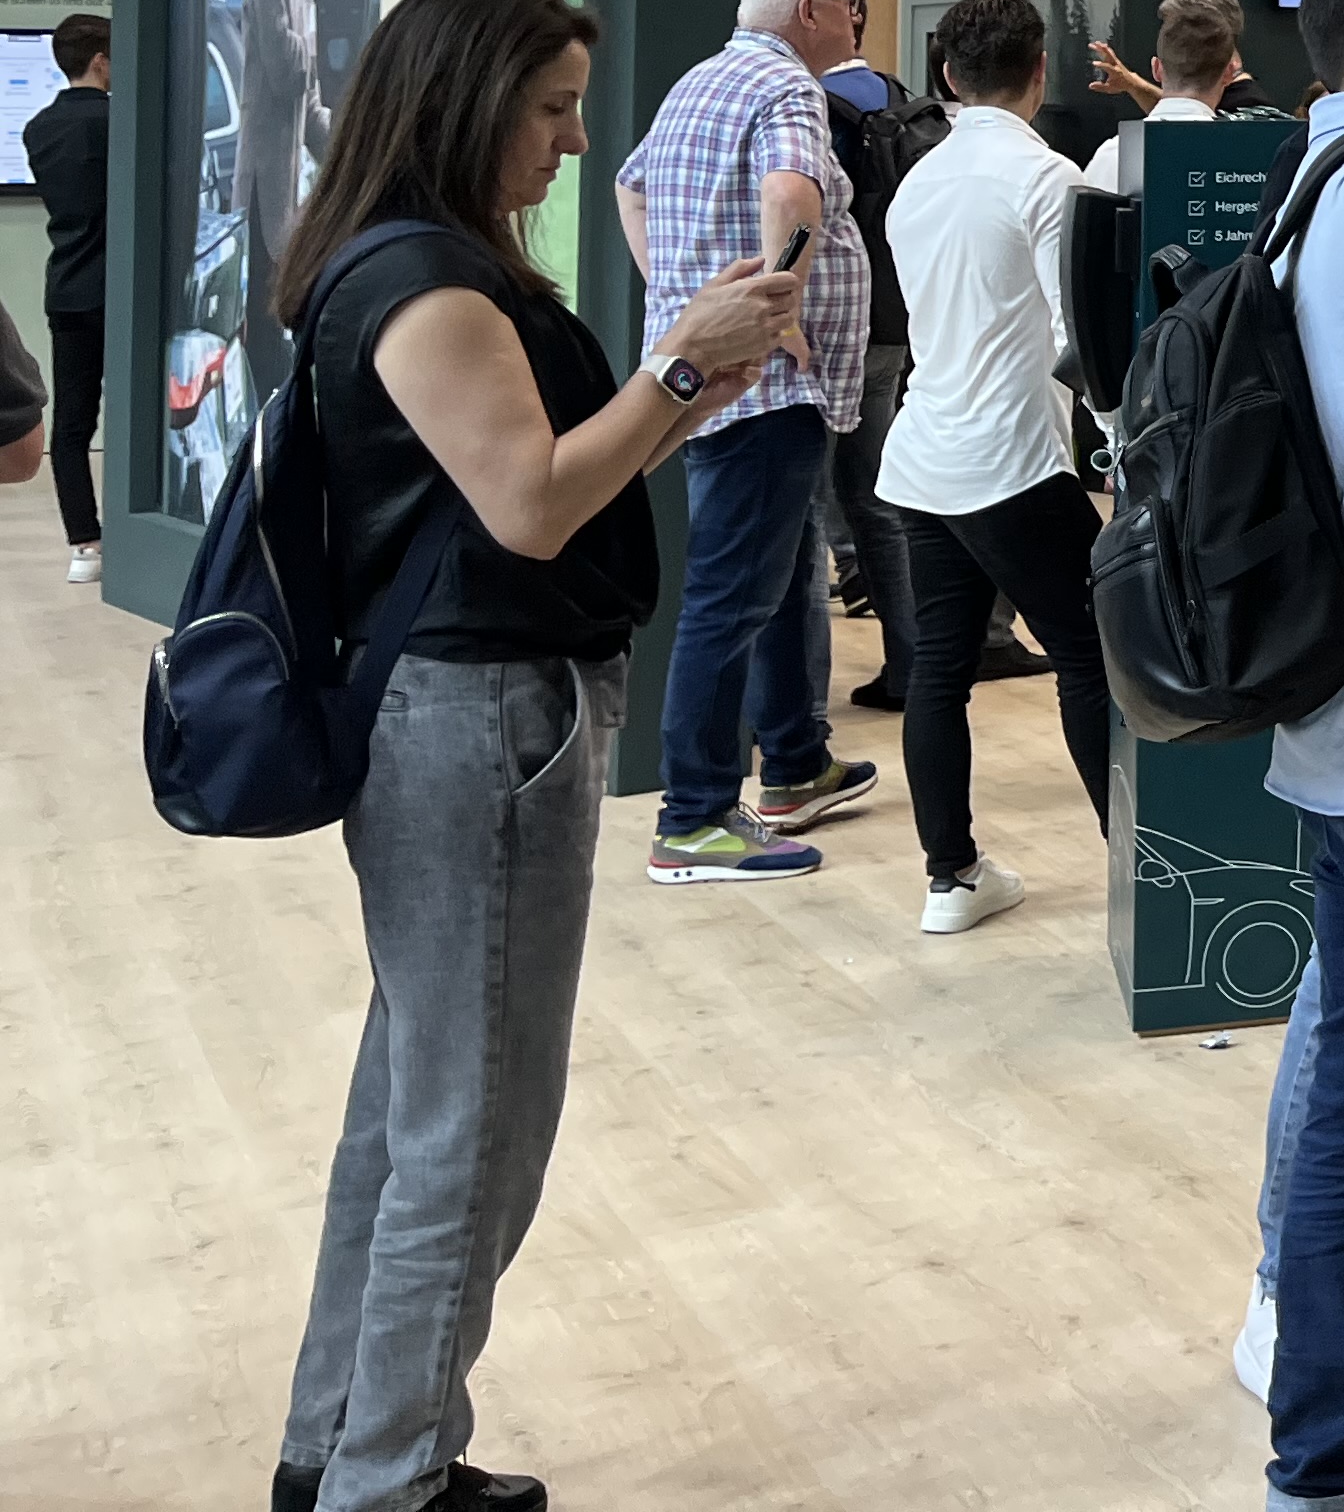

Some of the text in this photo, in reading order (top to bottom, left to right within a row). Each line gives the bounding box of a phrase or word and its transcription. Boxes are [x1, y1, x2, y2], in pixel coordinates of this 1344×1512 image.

[1215, 172, 1268, 184] Eichrech
[1215, 201, 1261, 215] Herges
[1215, 230, 1254, 242] 5 Jahr
